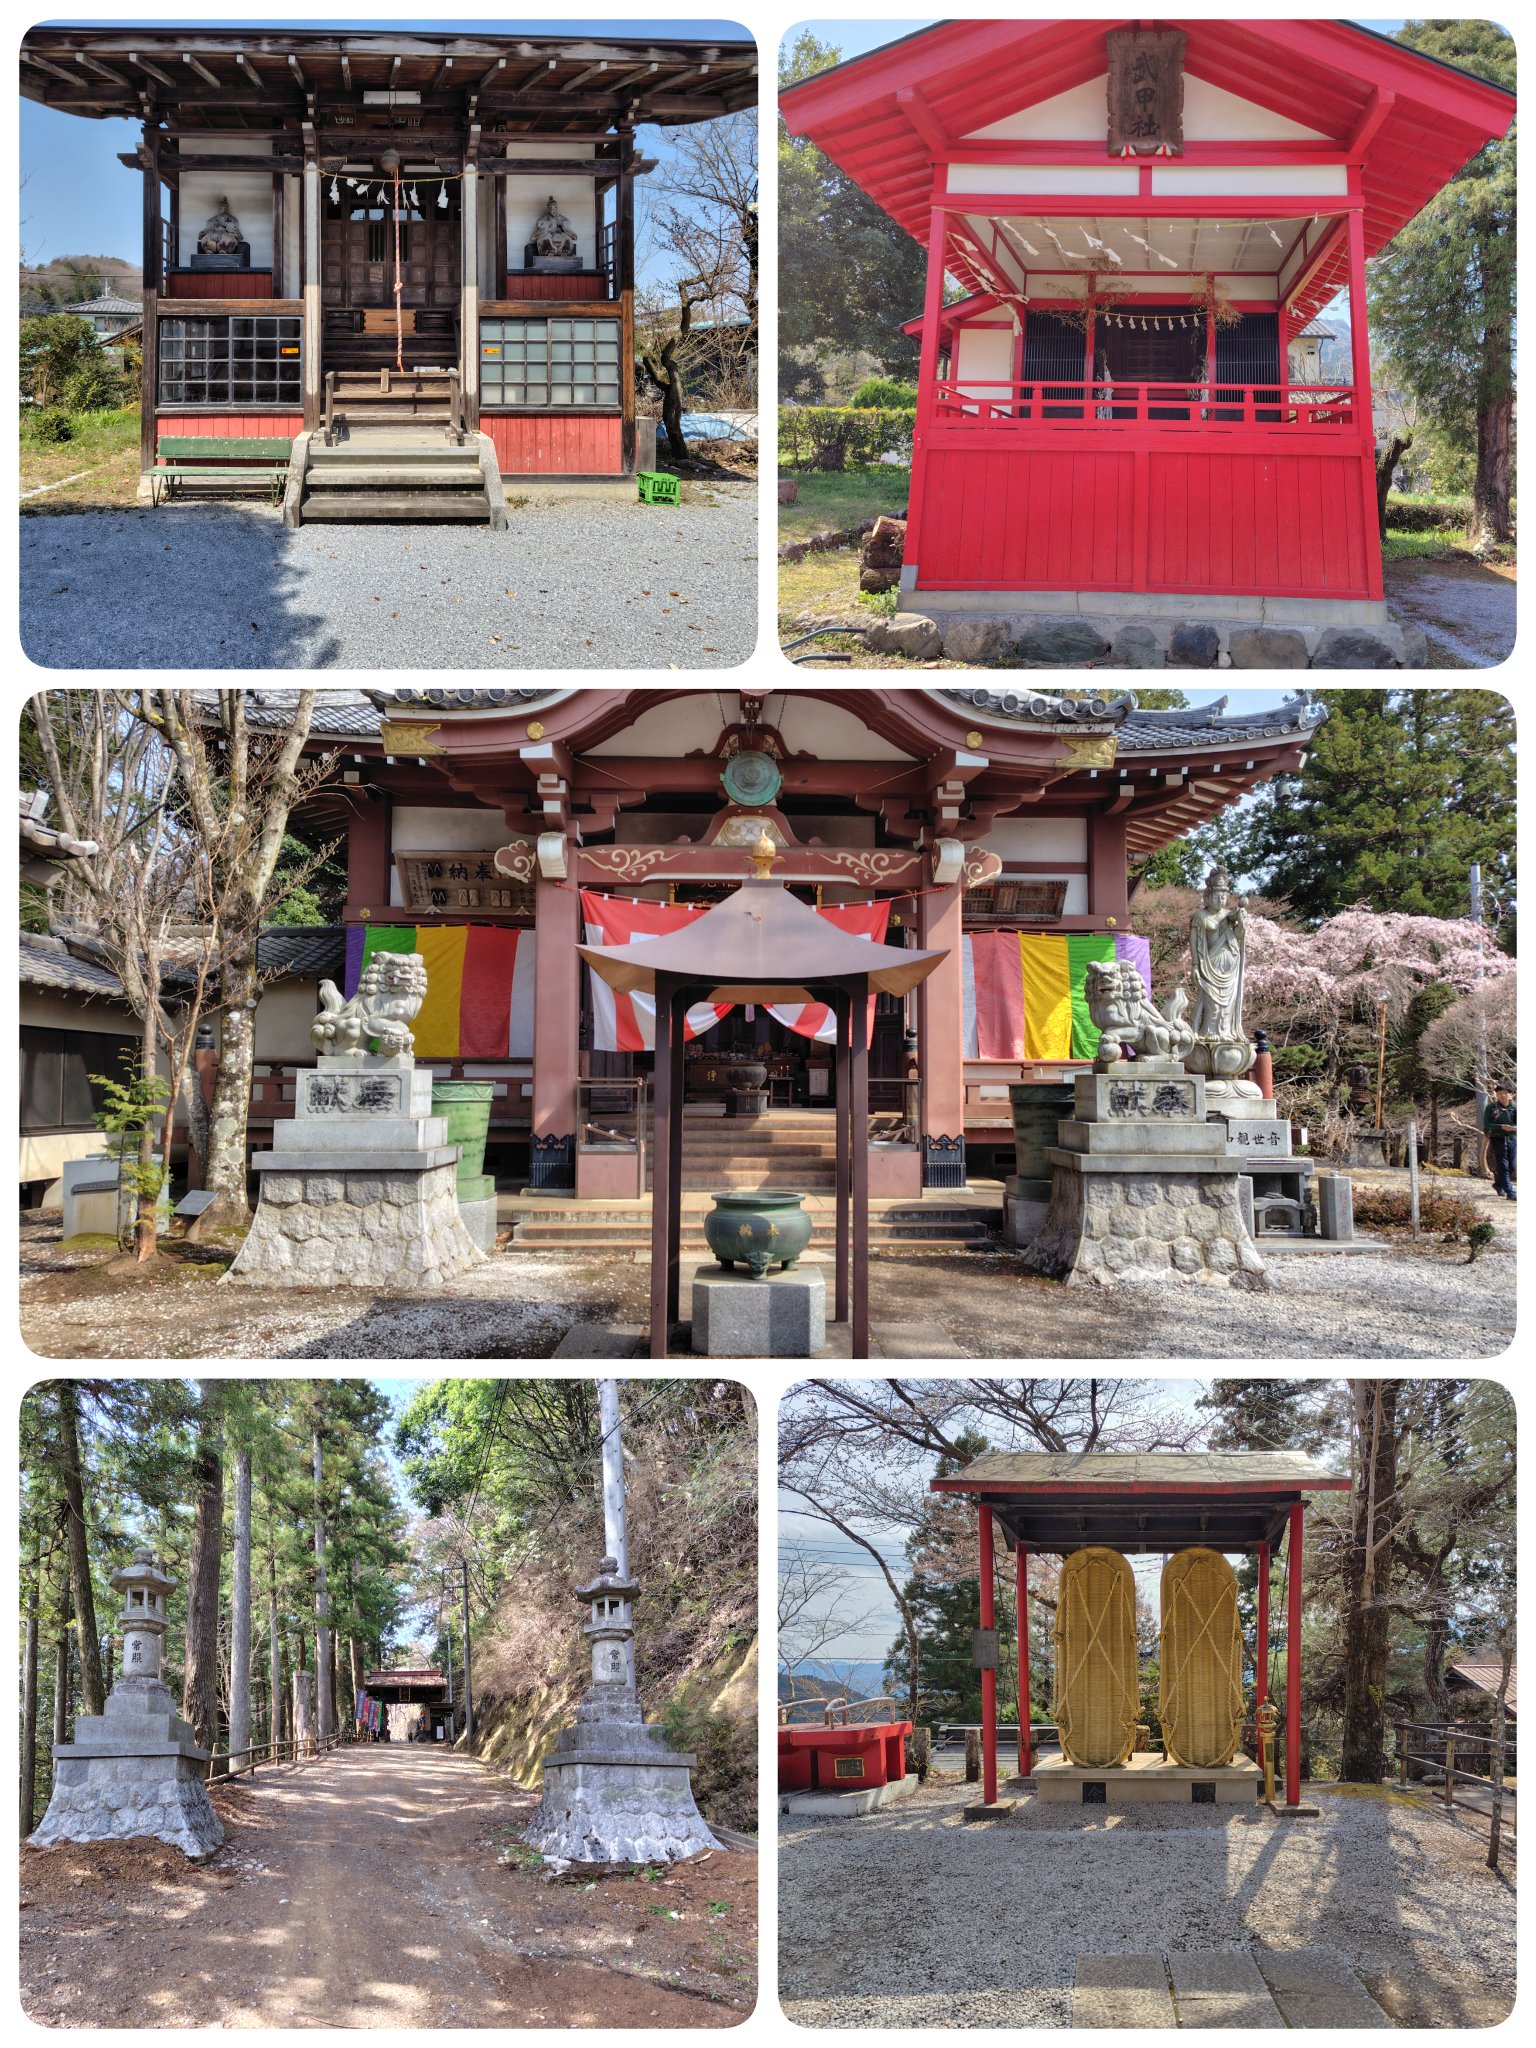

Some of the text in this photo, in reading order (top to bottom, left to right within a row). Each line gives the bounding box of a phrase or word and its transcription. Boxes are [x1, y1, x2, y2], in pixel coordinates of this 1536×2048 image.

[1128, 51, 1161, 138] 武甲社
[131, 1639, 143, 1663] 常照
[609, 1649, 620, 1673] 常照
